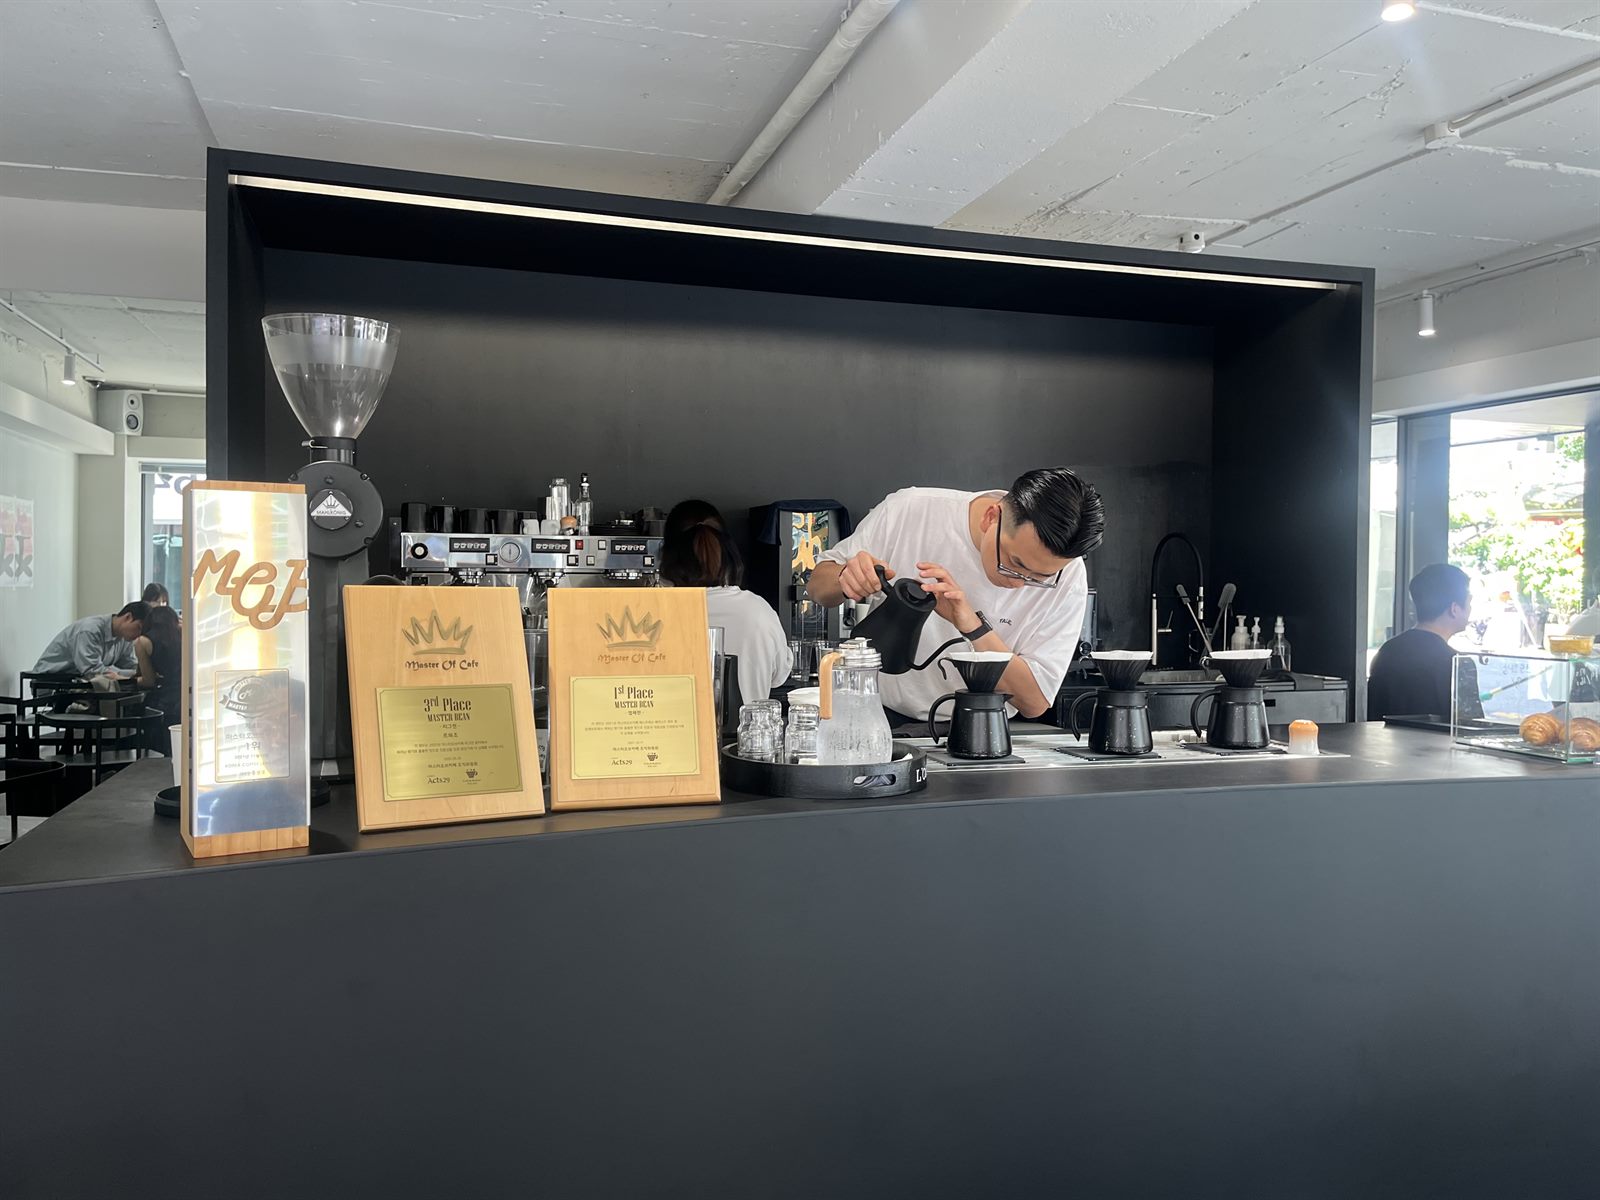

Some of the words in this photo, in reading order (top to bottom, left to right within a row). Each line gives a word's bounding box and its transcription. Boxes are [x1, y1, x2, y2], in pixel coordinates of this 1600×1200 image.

[597, 653, 630, 665] Master
[631, 653, 645, 664] Of
[647, 652, 666, 663] Cafe
[404, 660, 440, 672] Master
[441, 660, 457, 671] Of
[459, 659, 480, 671] Cafe
[614, 684, 625, 700] 1st
[627, 686, 654, 700] Place
[423, 695, 439, 713] 3rd
[442, 697, 472, 712] Place
[614, 700, 638, 709] MASTER
[639, 699, 654, 708] BEAN
[427, 713, 454, 722] MASTER
[454, 712, 471, 721] BEAN
[611, 758, 633, 767] Acts29
[427, 776, 451, 785] Acts29
